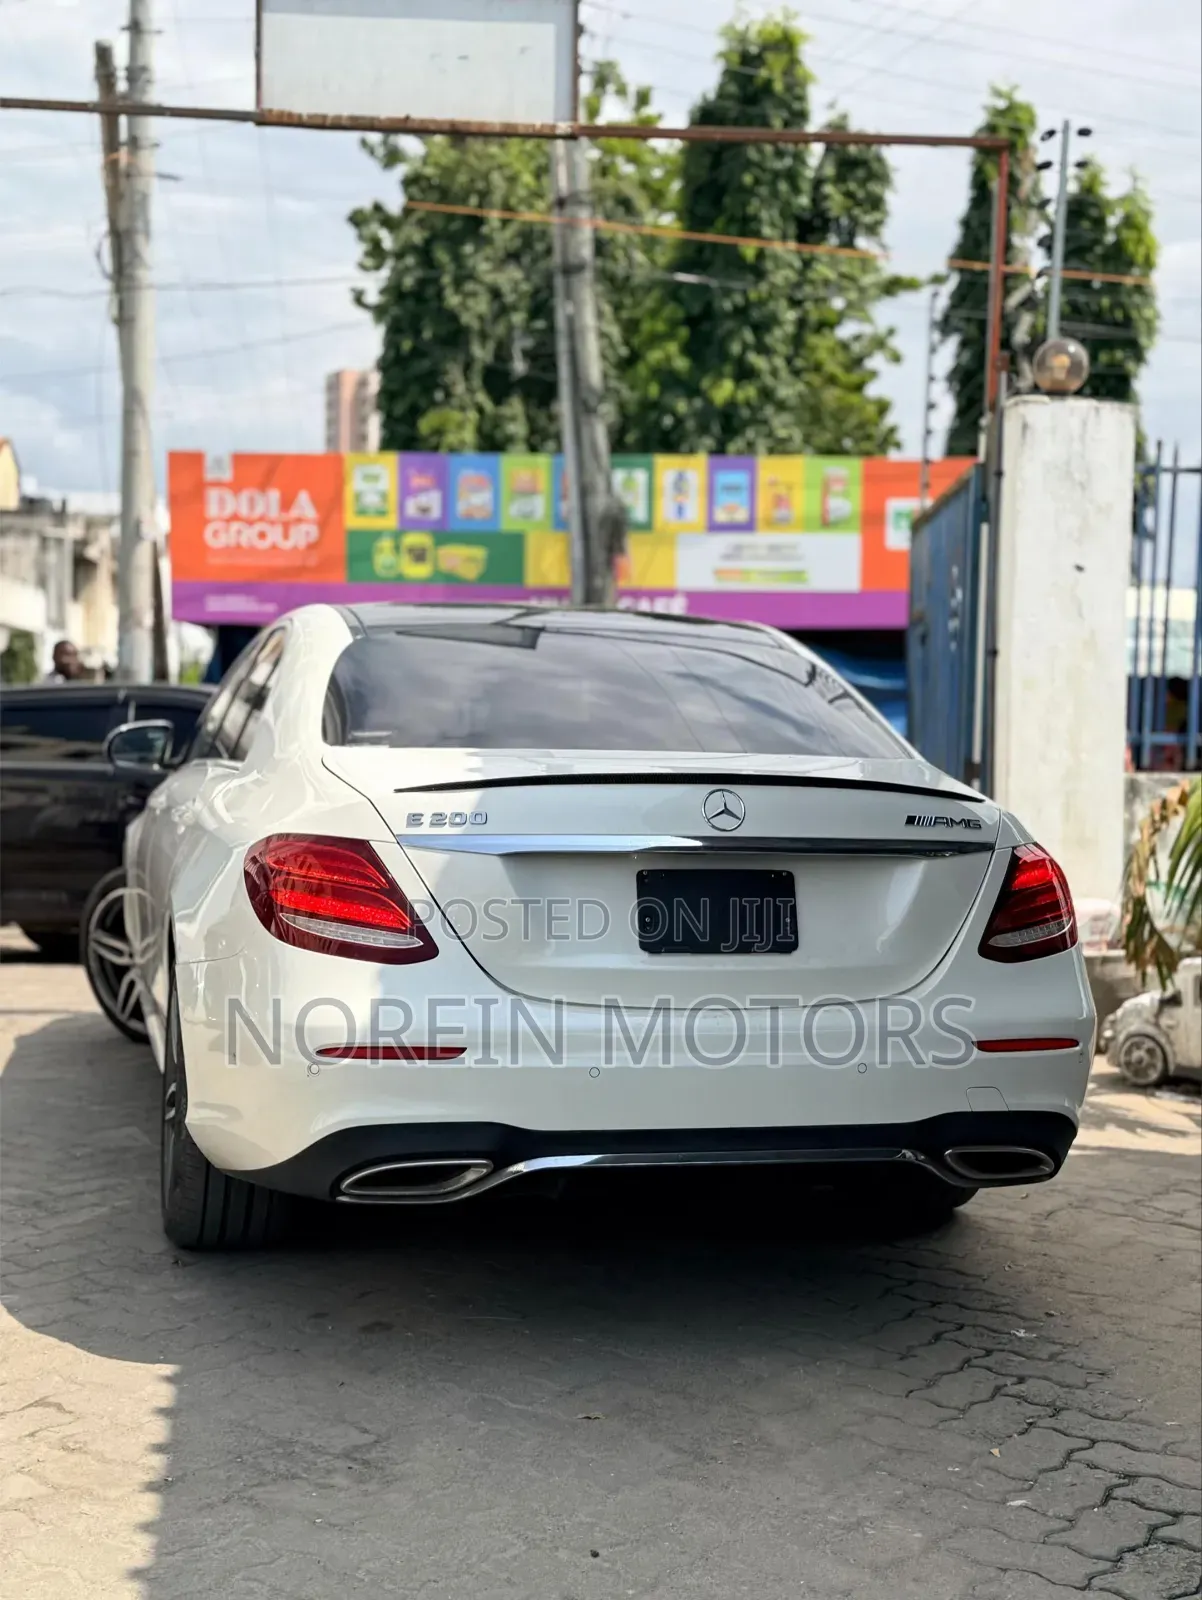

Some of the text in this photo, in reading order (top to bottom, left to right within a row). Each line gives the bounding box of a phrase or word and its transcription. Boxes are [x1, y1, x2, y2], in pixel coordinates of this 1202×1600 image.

[204, 486, 318, 520] DOLA
[203, 520, 320, 550] GROUP
[405, 811, 488, 828] E 200
[932, 815, 982, 830] AMG
